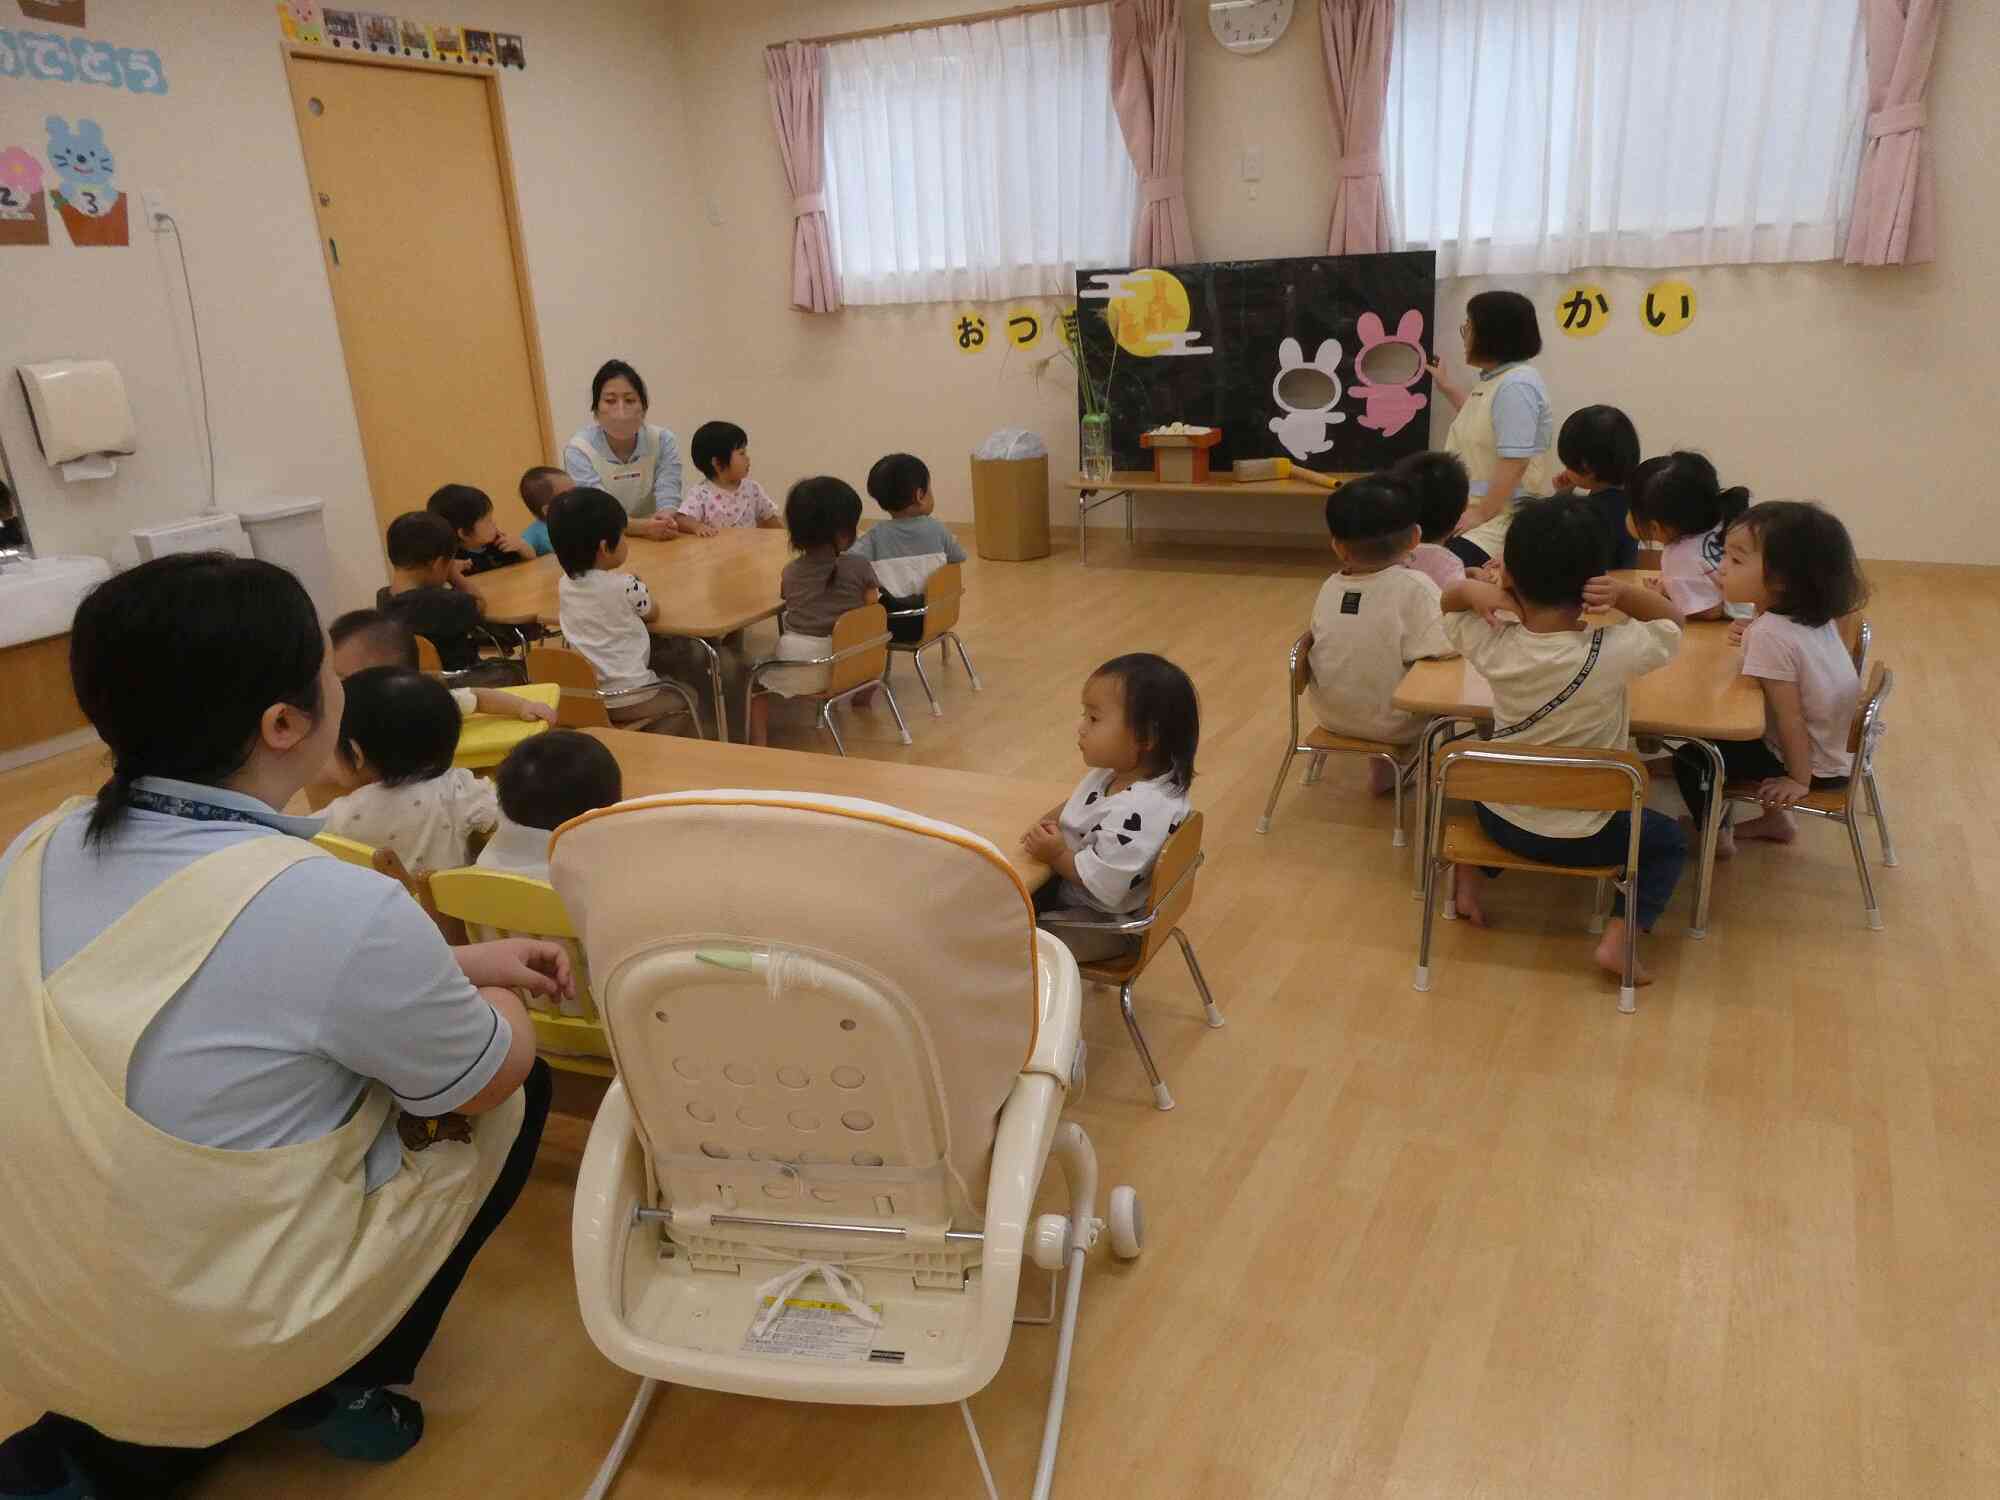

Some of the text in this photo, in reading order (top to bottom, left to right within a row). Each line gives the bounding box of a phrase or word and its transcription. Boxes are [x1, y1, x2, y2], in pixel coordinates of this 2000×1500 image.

[0, 186, 18, 206] 2
[81, 191, 98, 214] 3
[1563, 290, 1690, 329] かい
